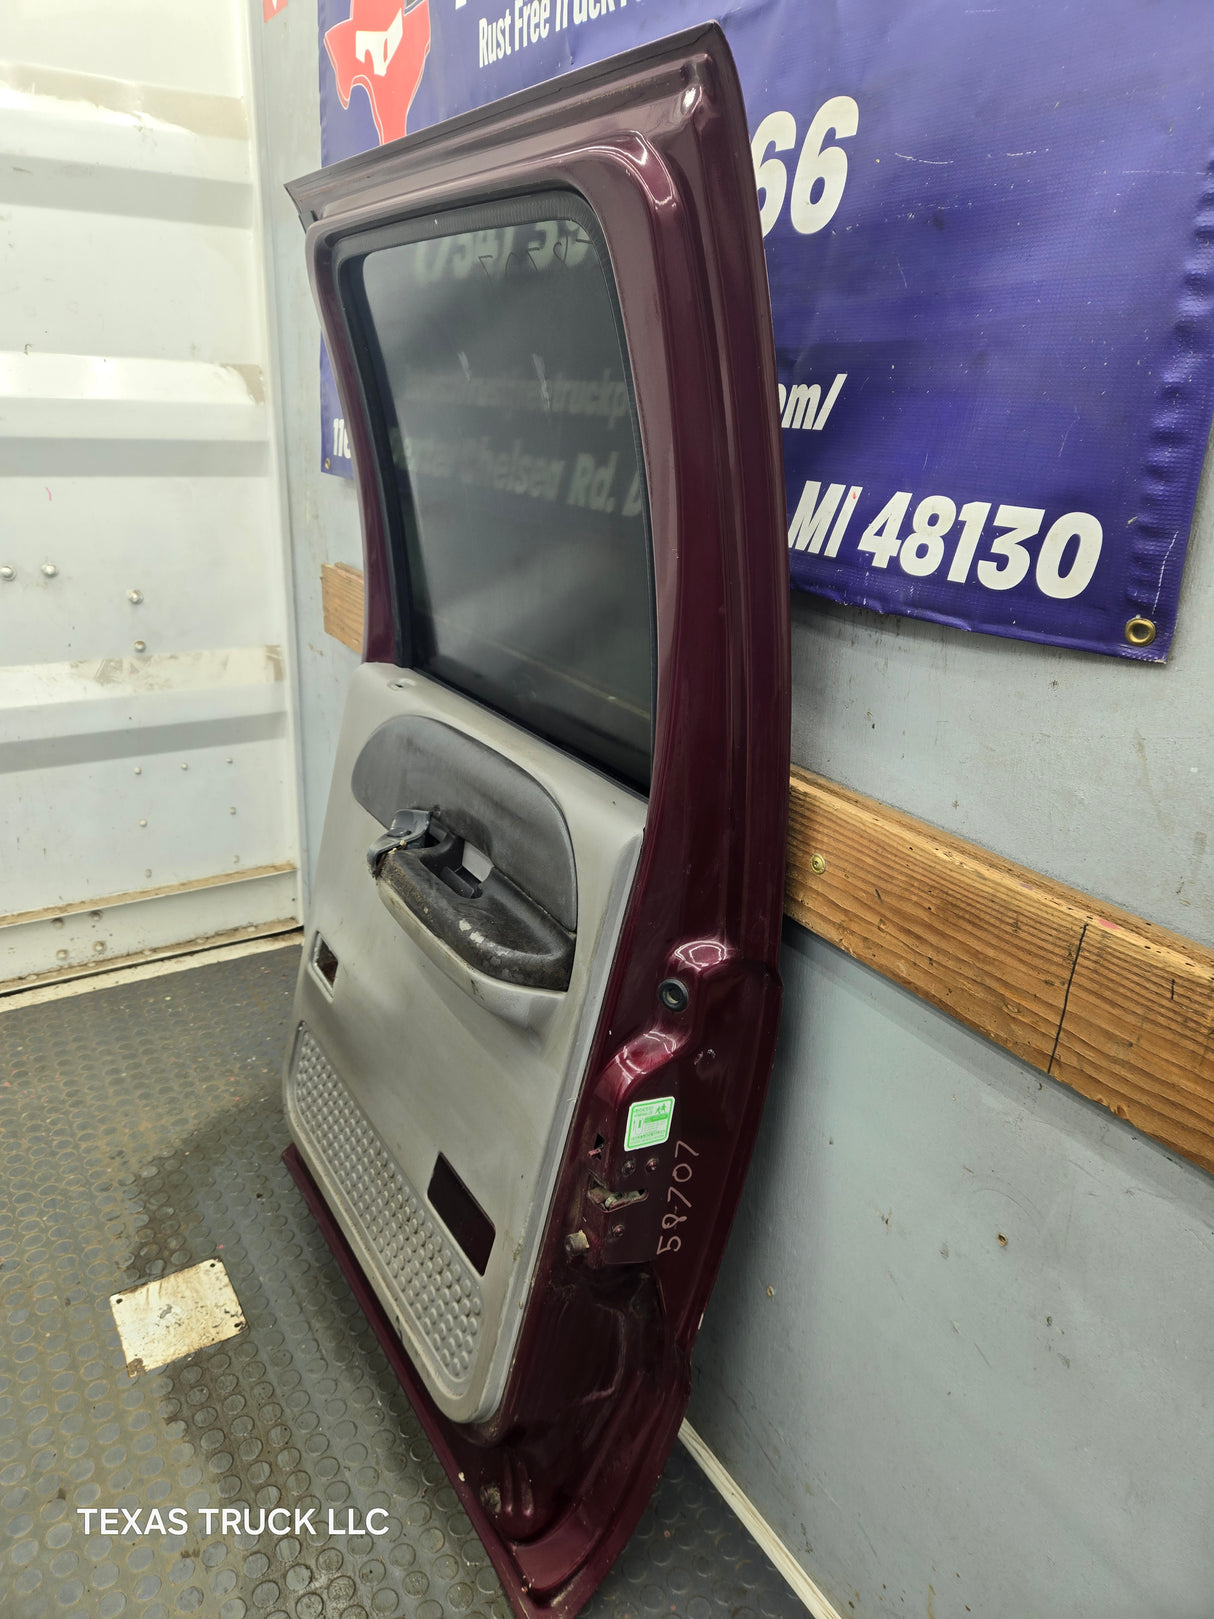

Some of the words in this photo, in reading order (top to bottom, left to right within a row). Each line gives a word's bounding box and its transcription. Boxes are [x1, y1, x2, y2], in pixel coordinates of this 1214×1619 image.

[479, 9, 512, 69] Rust
[515, 0, 550, 51] Free
[567, 451, 619, 514] Rd.
[788, 480, 863, 558] MI
[857, 491, 1104, 600] 48130
